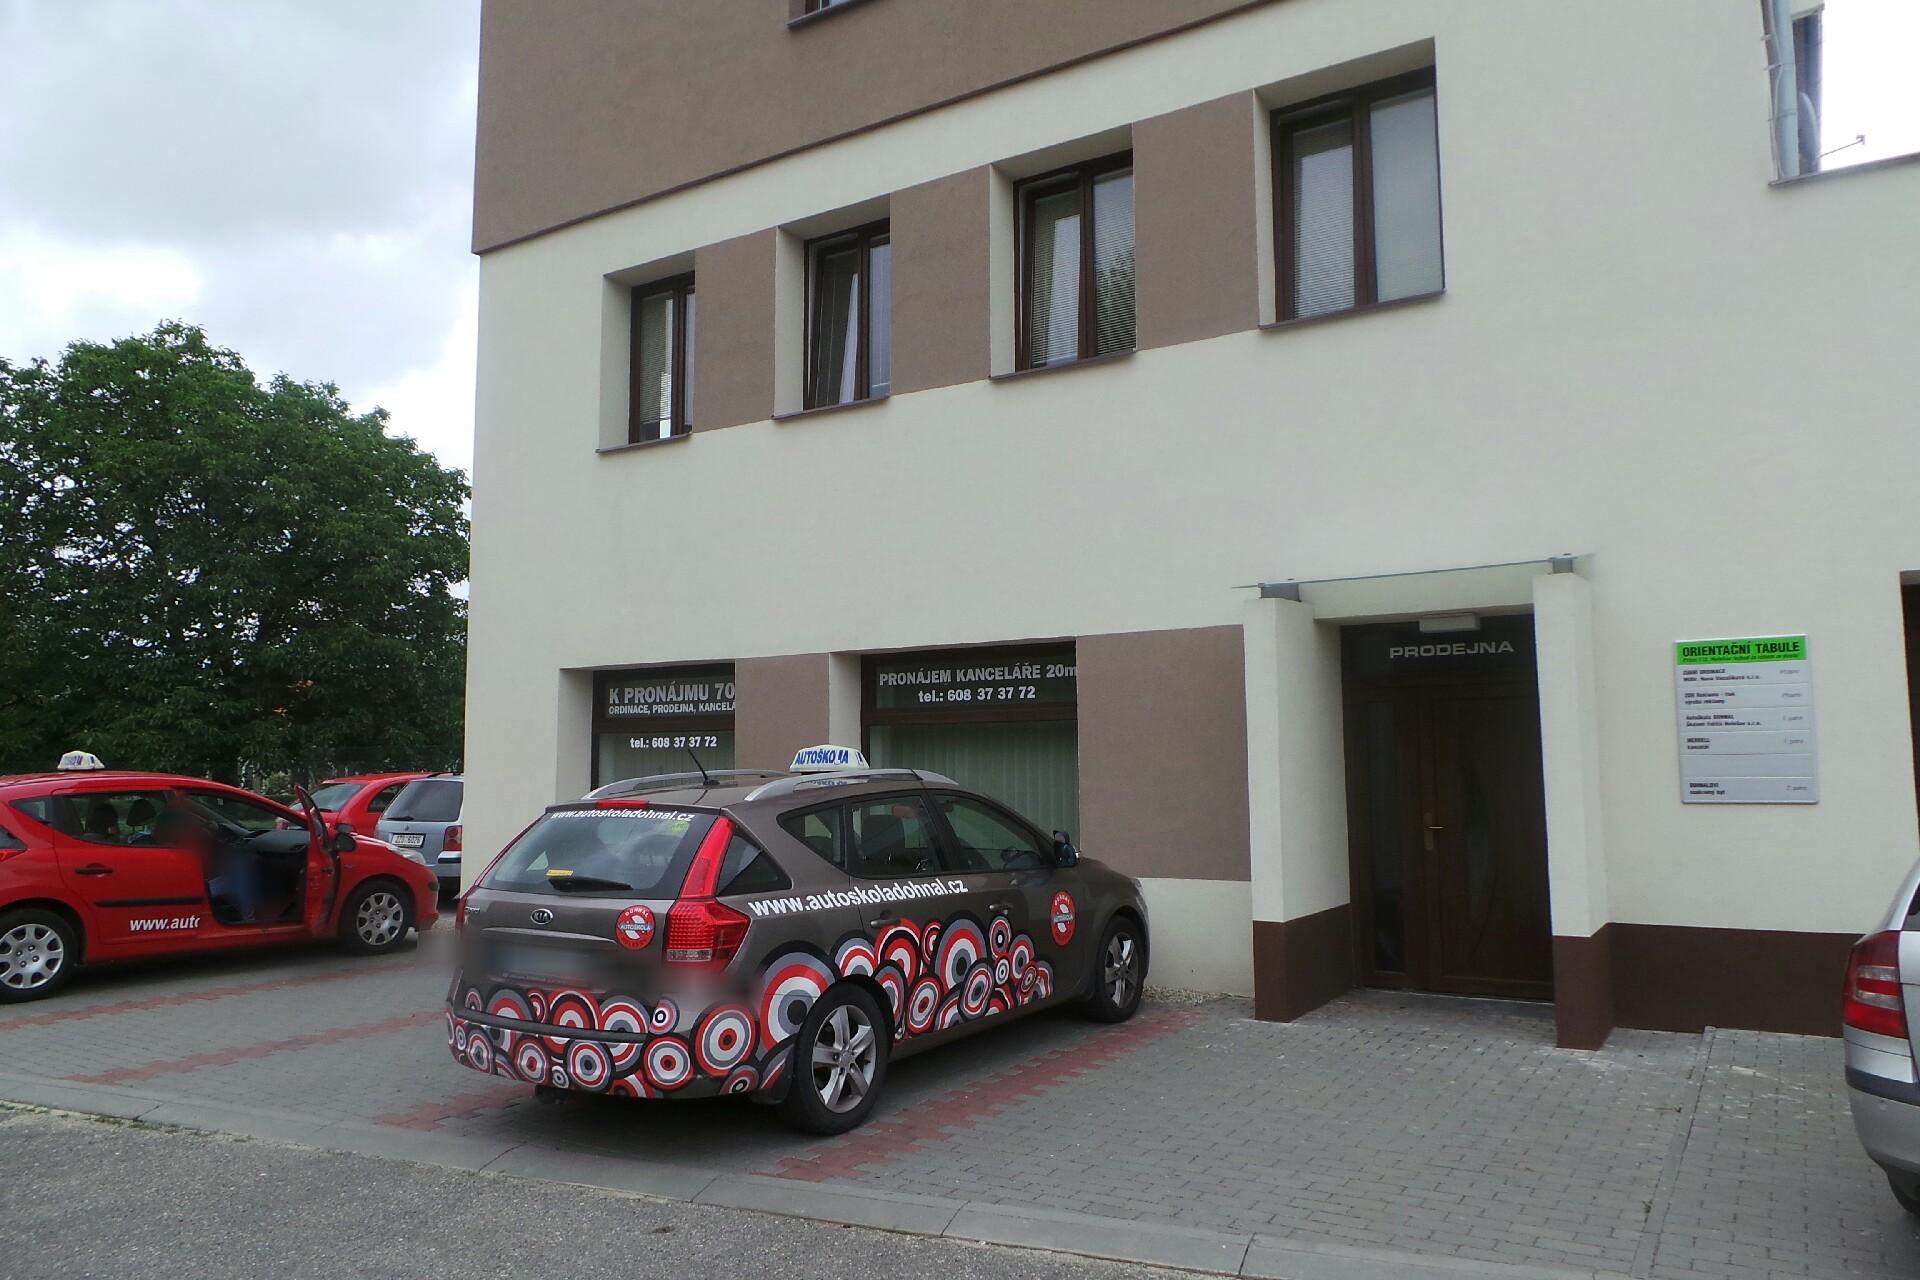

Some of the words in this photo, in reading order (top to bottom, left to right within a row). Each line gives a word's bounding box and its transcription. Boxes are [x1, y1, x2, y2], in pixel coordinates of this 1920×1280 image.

[1389, 641, 1514, 659] PRODEJNA
[1682, 641, 1751, 657] ORIENTAČNÍ
[1755, 642, 1800, 654] TABULE
[879, 668, 951, 686] PRONÁJEM
[956, 662, 1041, 682] KANCELÁŘE
[609, 688, 620, 704] K
[624, 681, 709, 704] PRONÁJMU
[715, 683, 735, 700] 70
[918, 690, 943, 702] tel.:
[947, 688, 971, 701] 608
[977, 688, 993, 700] 37
[998, 687, 1014, 699] 37
[1019, 686, 1036, 699] 72
[609, 705, 651, 715] ORDINACE,
[652, 703, 696, 714] PRODEJNA,
[630, 738, 649, 748] tel.:
[651, 737, 670, 748] 608
[673, 737, 686, 747] 37
[688, 736, 701, 747] 37
[704, 736, 717, 747] 72
[551, 808, 695, 822] www.autoskoladohnal.cz
[748, 878, 968, 916] www.autoskoladohnal.cz
[534, 912, 550, 921] KIA
